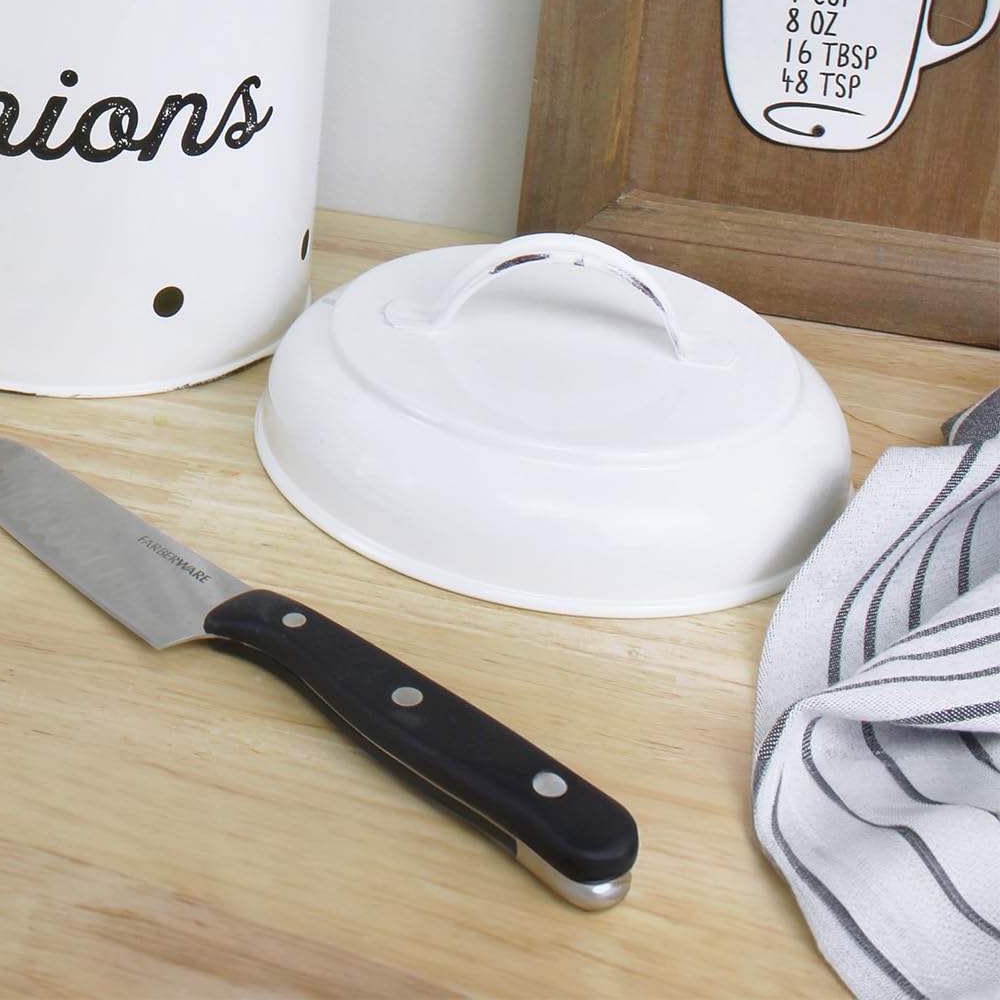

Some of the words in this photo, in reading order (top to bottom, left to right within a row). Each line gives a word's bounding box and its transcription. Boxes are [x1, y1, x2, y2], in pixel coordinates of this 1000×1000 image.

[786, 7, 800, 33] 8
[810, 10, 839, 37] OZ
[786, 38, 812, 65] 16
[821, 41, 878, 71] TBSP
[781, 67, 809, 95] 48
[819, 72, 861, 99] TSP
[137, 535, 212, 584] FARBERWARE
